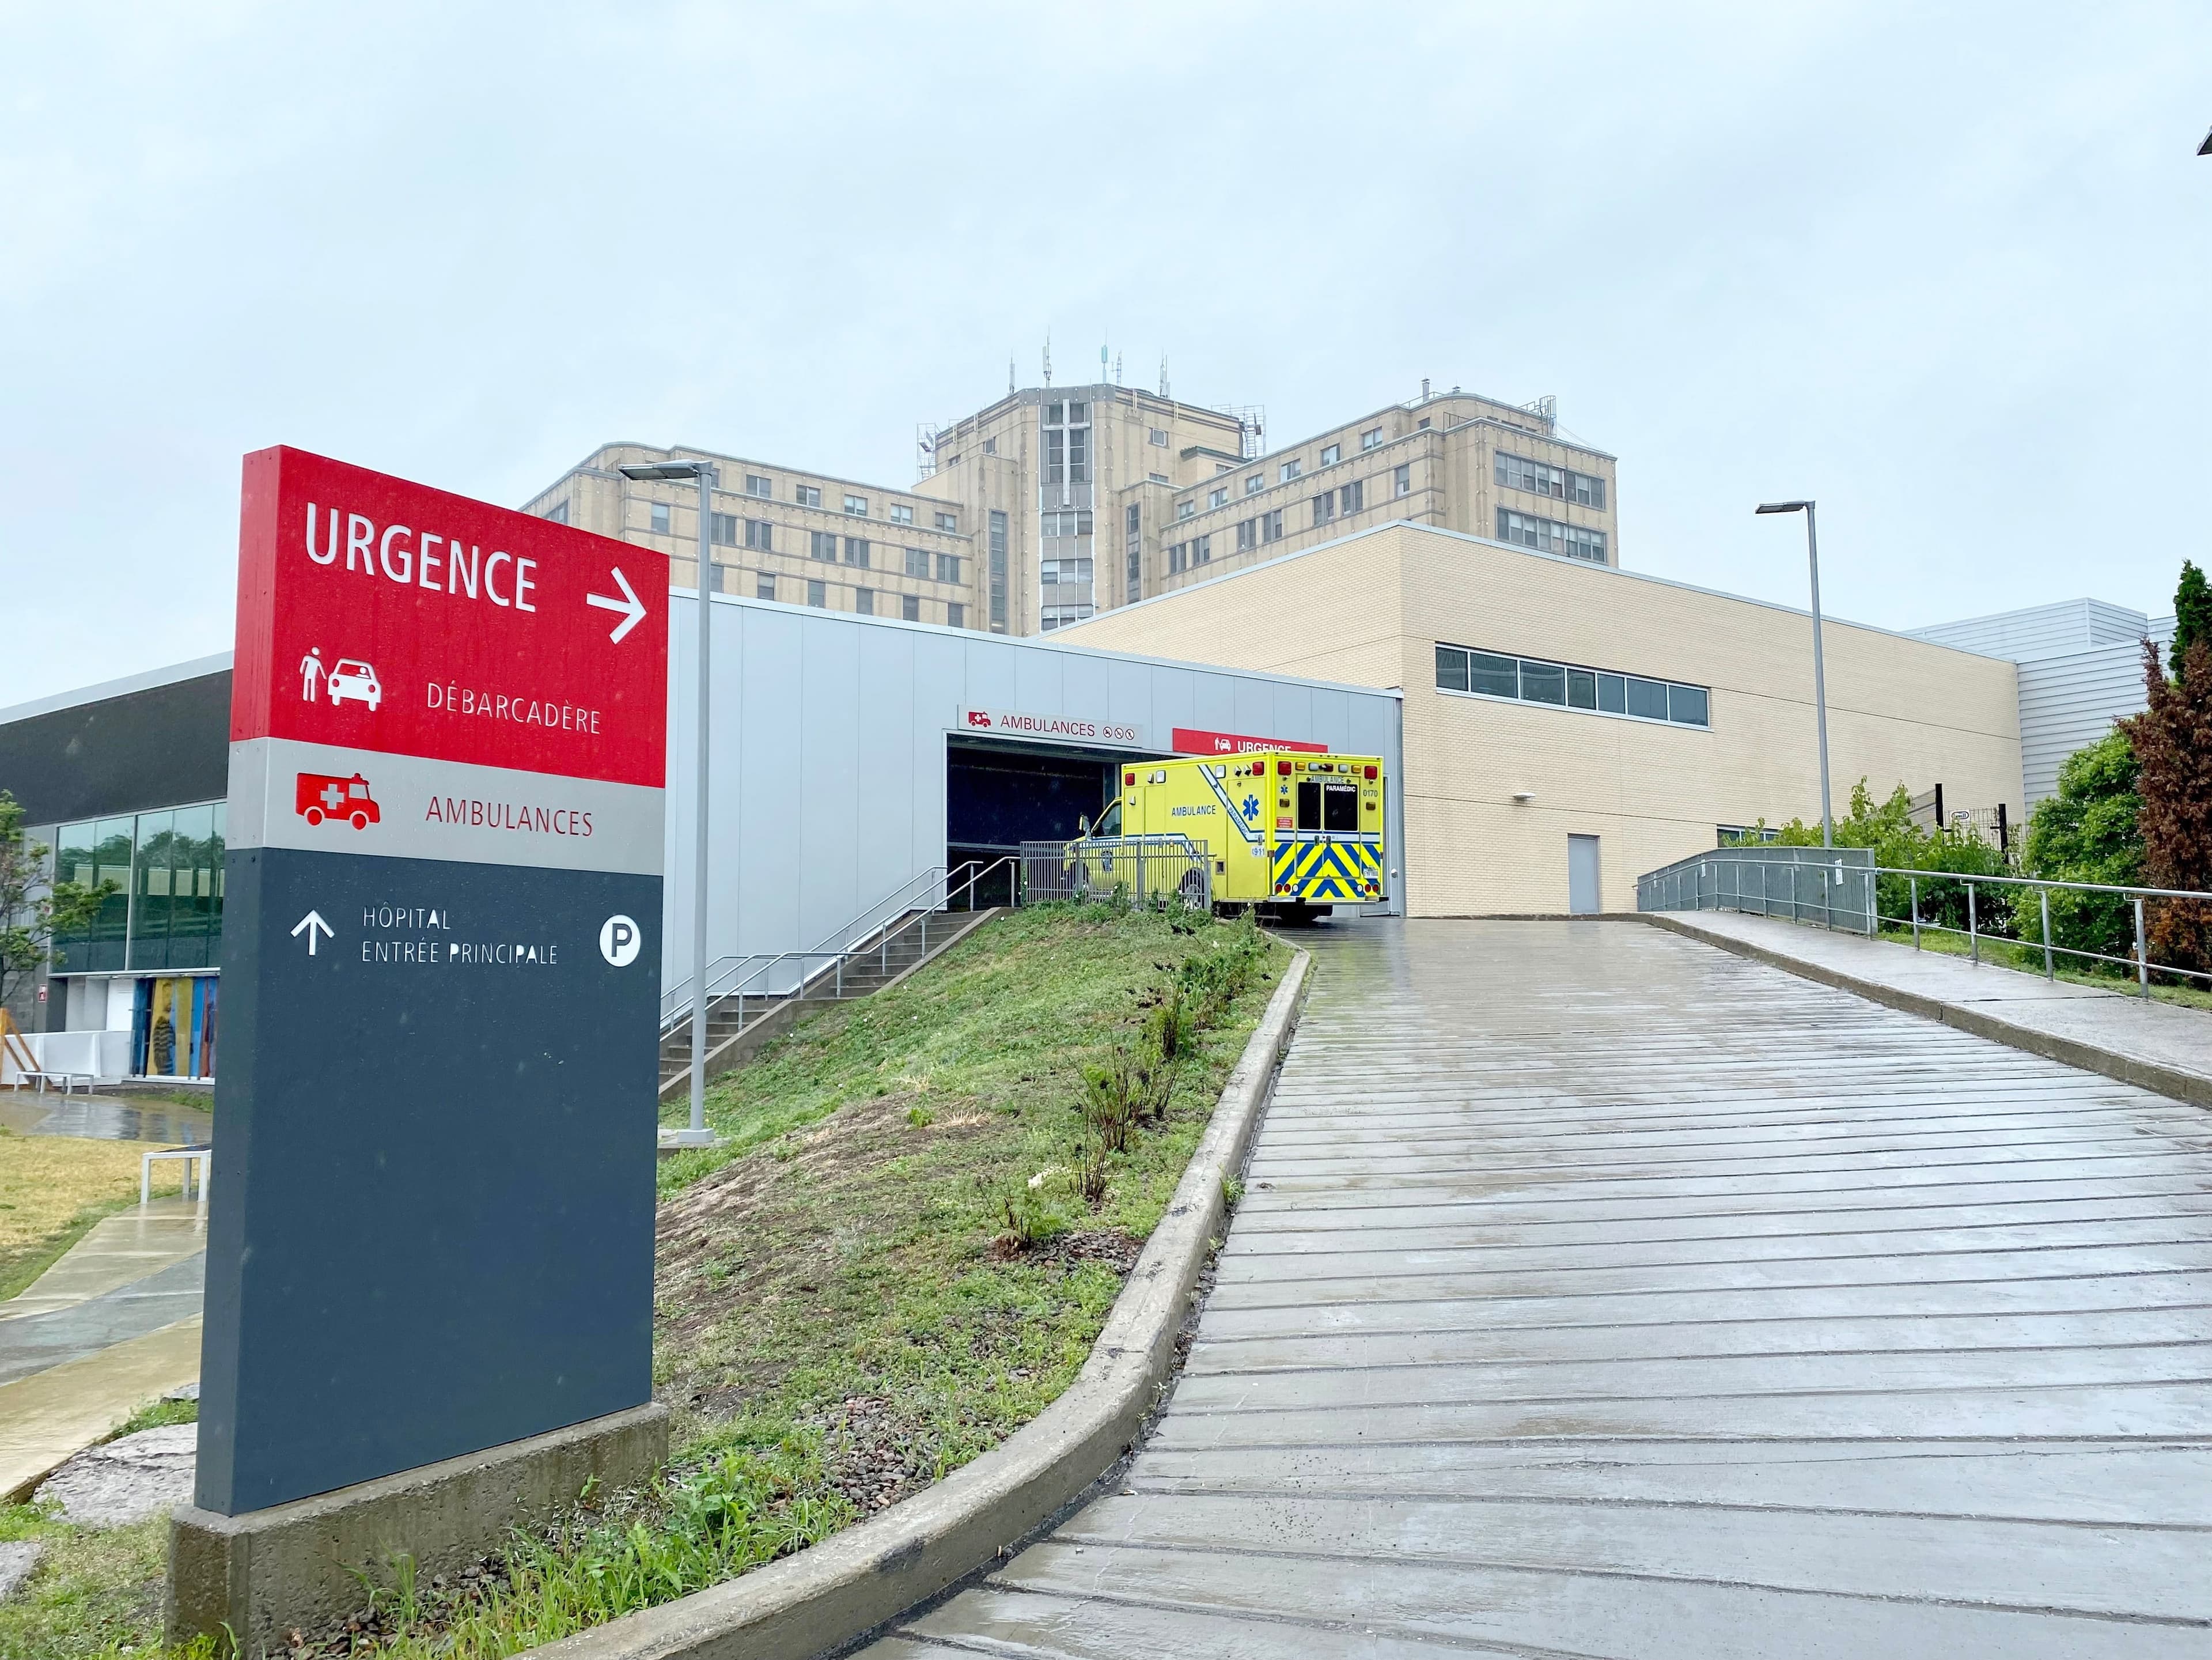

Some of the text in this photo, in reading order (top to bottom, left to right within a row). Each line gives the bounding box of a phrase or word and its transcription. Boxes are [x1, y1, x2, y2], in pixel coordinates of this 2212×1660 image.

[305, 502, 537, 612] URGENCE
[427, 680, 601, 735] DÉBARCADÈRE
[1001, 715, 1095, 736] AMBULANCES
[1309, 775, 1344, 784] AMBULANCE
[425, 796, 593, 837] AMBULANCES
[1172, 805, 1216, 816] AMBULANCE
[363, 901, 451, 930] HÔPITAL
[361, 937, 558, 965] ENTRÉE PRINCIPALE
[611, 923, 632, 957] P
